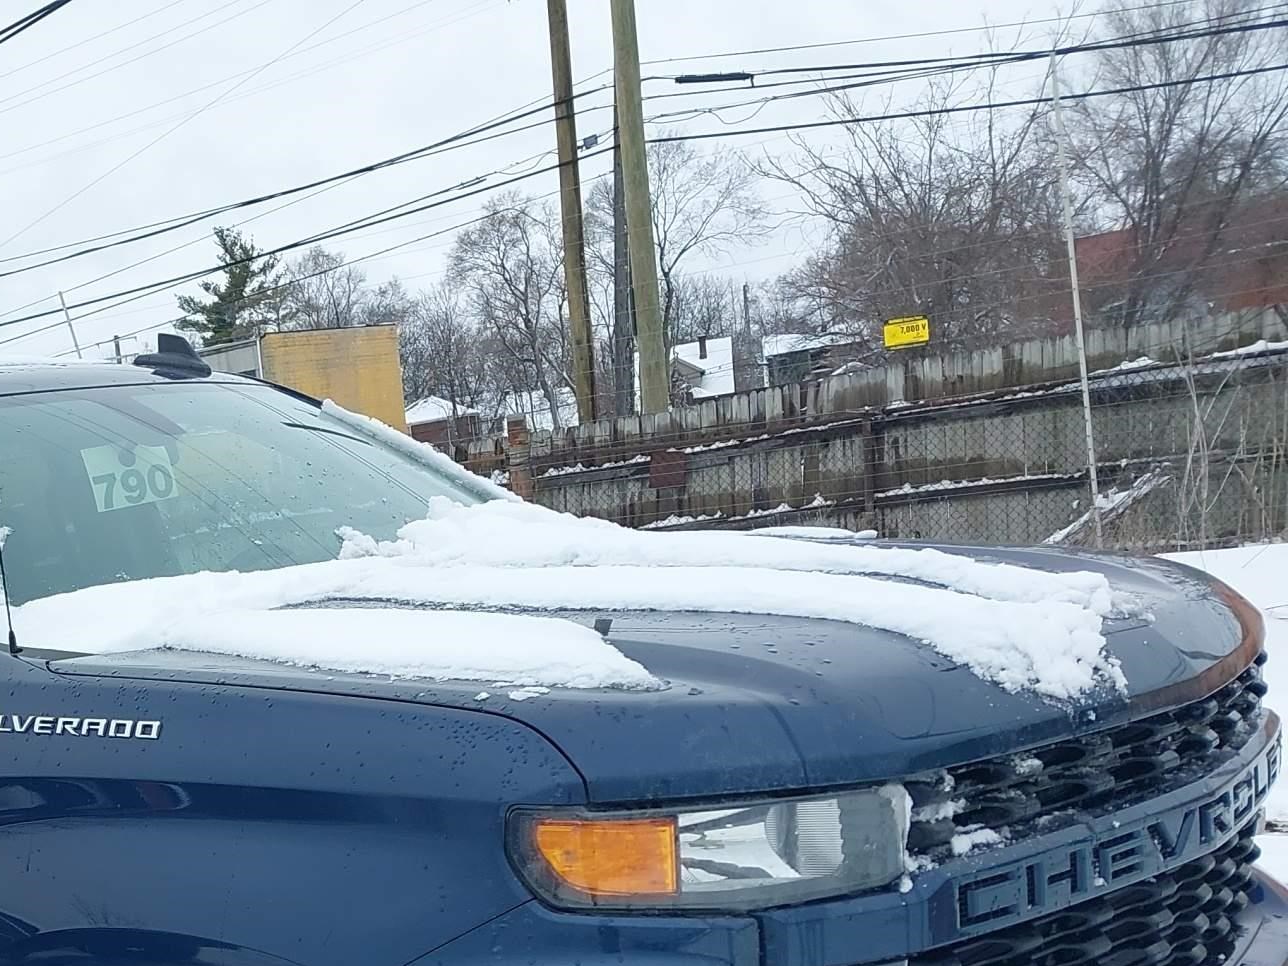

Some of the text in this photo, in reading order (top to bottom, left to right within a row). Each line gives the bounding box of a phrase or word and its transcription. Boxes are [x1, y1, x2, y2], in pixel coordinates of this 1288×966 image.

[900, 322, 927, 335] 7,000 V
[91, 463, 174, 510] 790
[959, 736, 1282, 929] CHEVROLE
